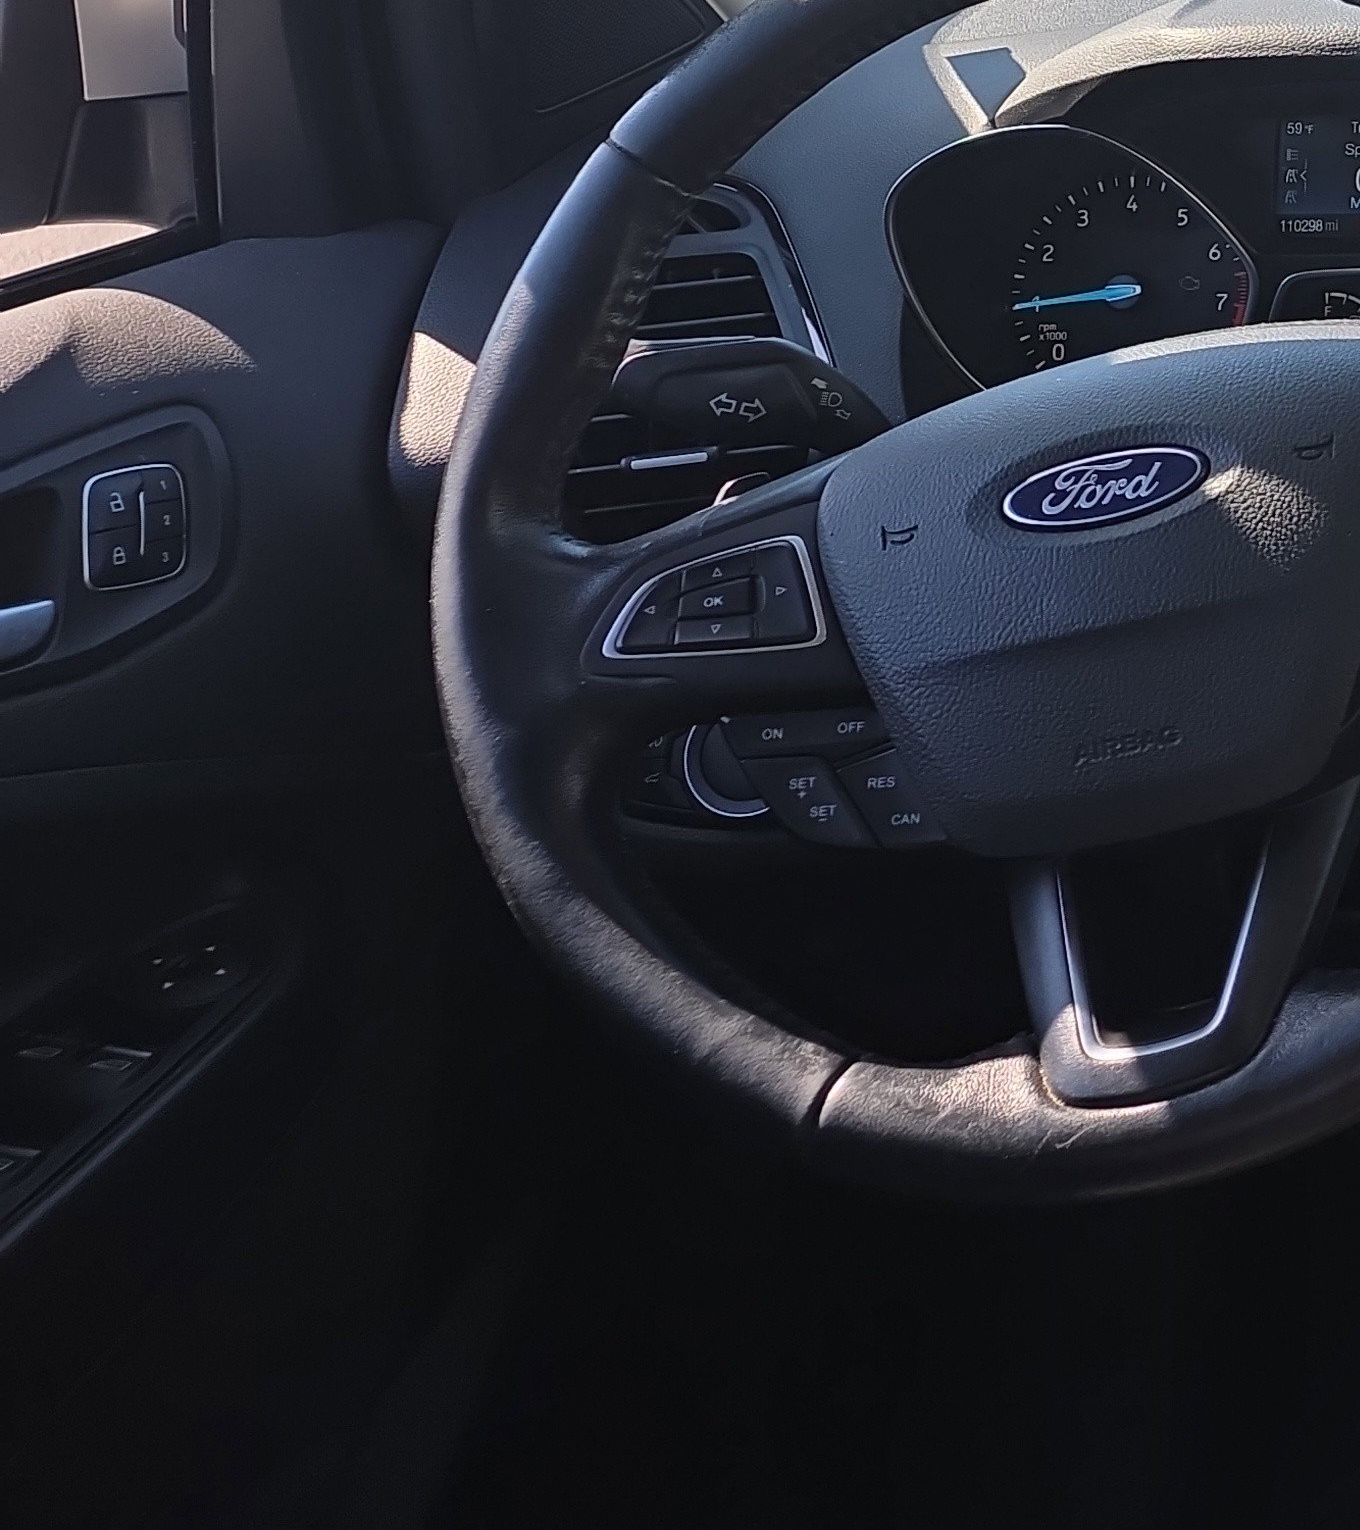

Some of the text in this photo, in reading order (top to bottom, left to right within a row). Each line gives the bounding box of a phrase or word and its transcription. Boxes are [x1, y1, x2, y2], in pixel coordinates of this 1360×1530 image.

[1126, 194, 1138, 212] 4
[1076, 209, 1090, 227] 3
[1177, 208, 1189, 226] 5
[1280, 219, 1339, 233] 110298 mi
[1042, 244, 1054, 262] 2
[1208, 243, 1221, 261] 6
[1215, 293, 1229, 311] 7
[1324, 305, 1332, 317] F
[1038, 323, 1057, 332] rpm
[1038, 331, 1068, 341] x1000
[1052, 343, 1065, 361] 0
[1041, 458, 1162, 516] Ford
[163, 515, 171, 526] 2
[162, 551, 170, 563] 3
[703, 596, 725, 608] OK
[762, 728, 784, 740] ON
[837, 721, 866, 734] OFF
[867, 776, 896, 790] RES
[891, 813, 921, 826] CAN
